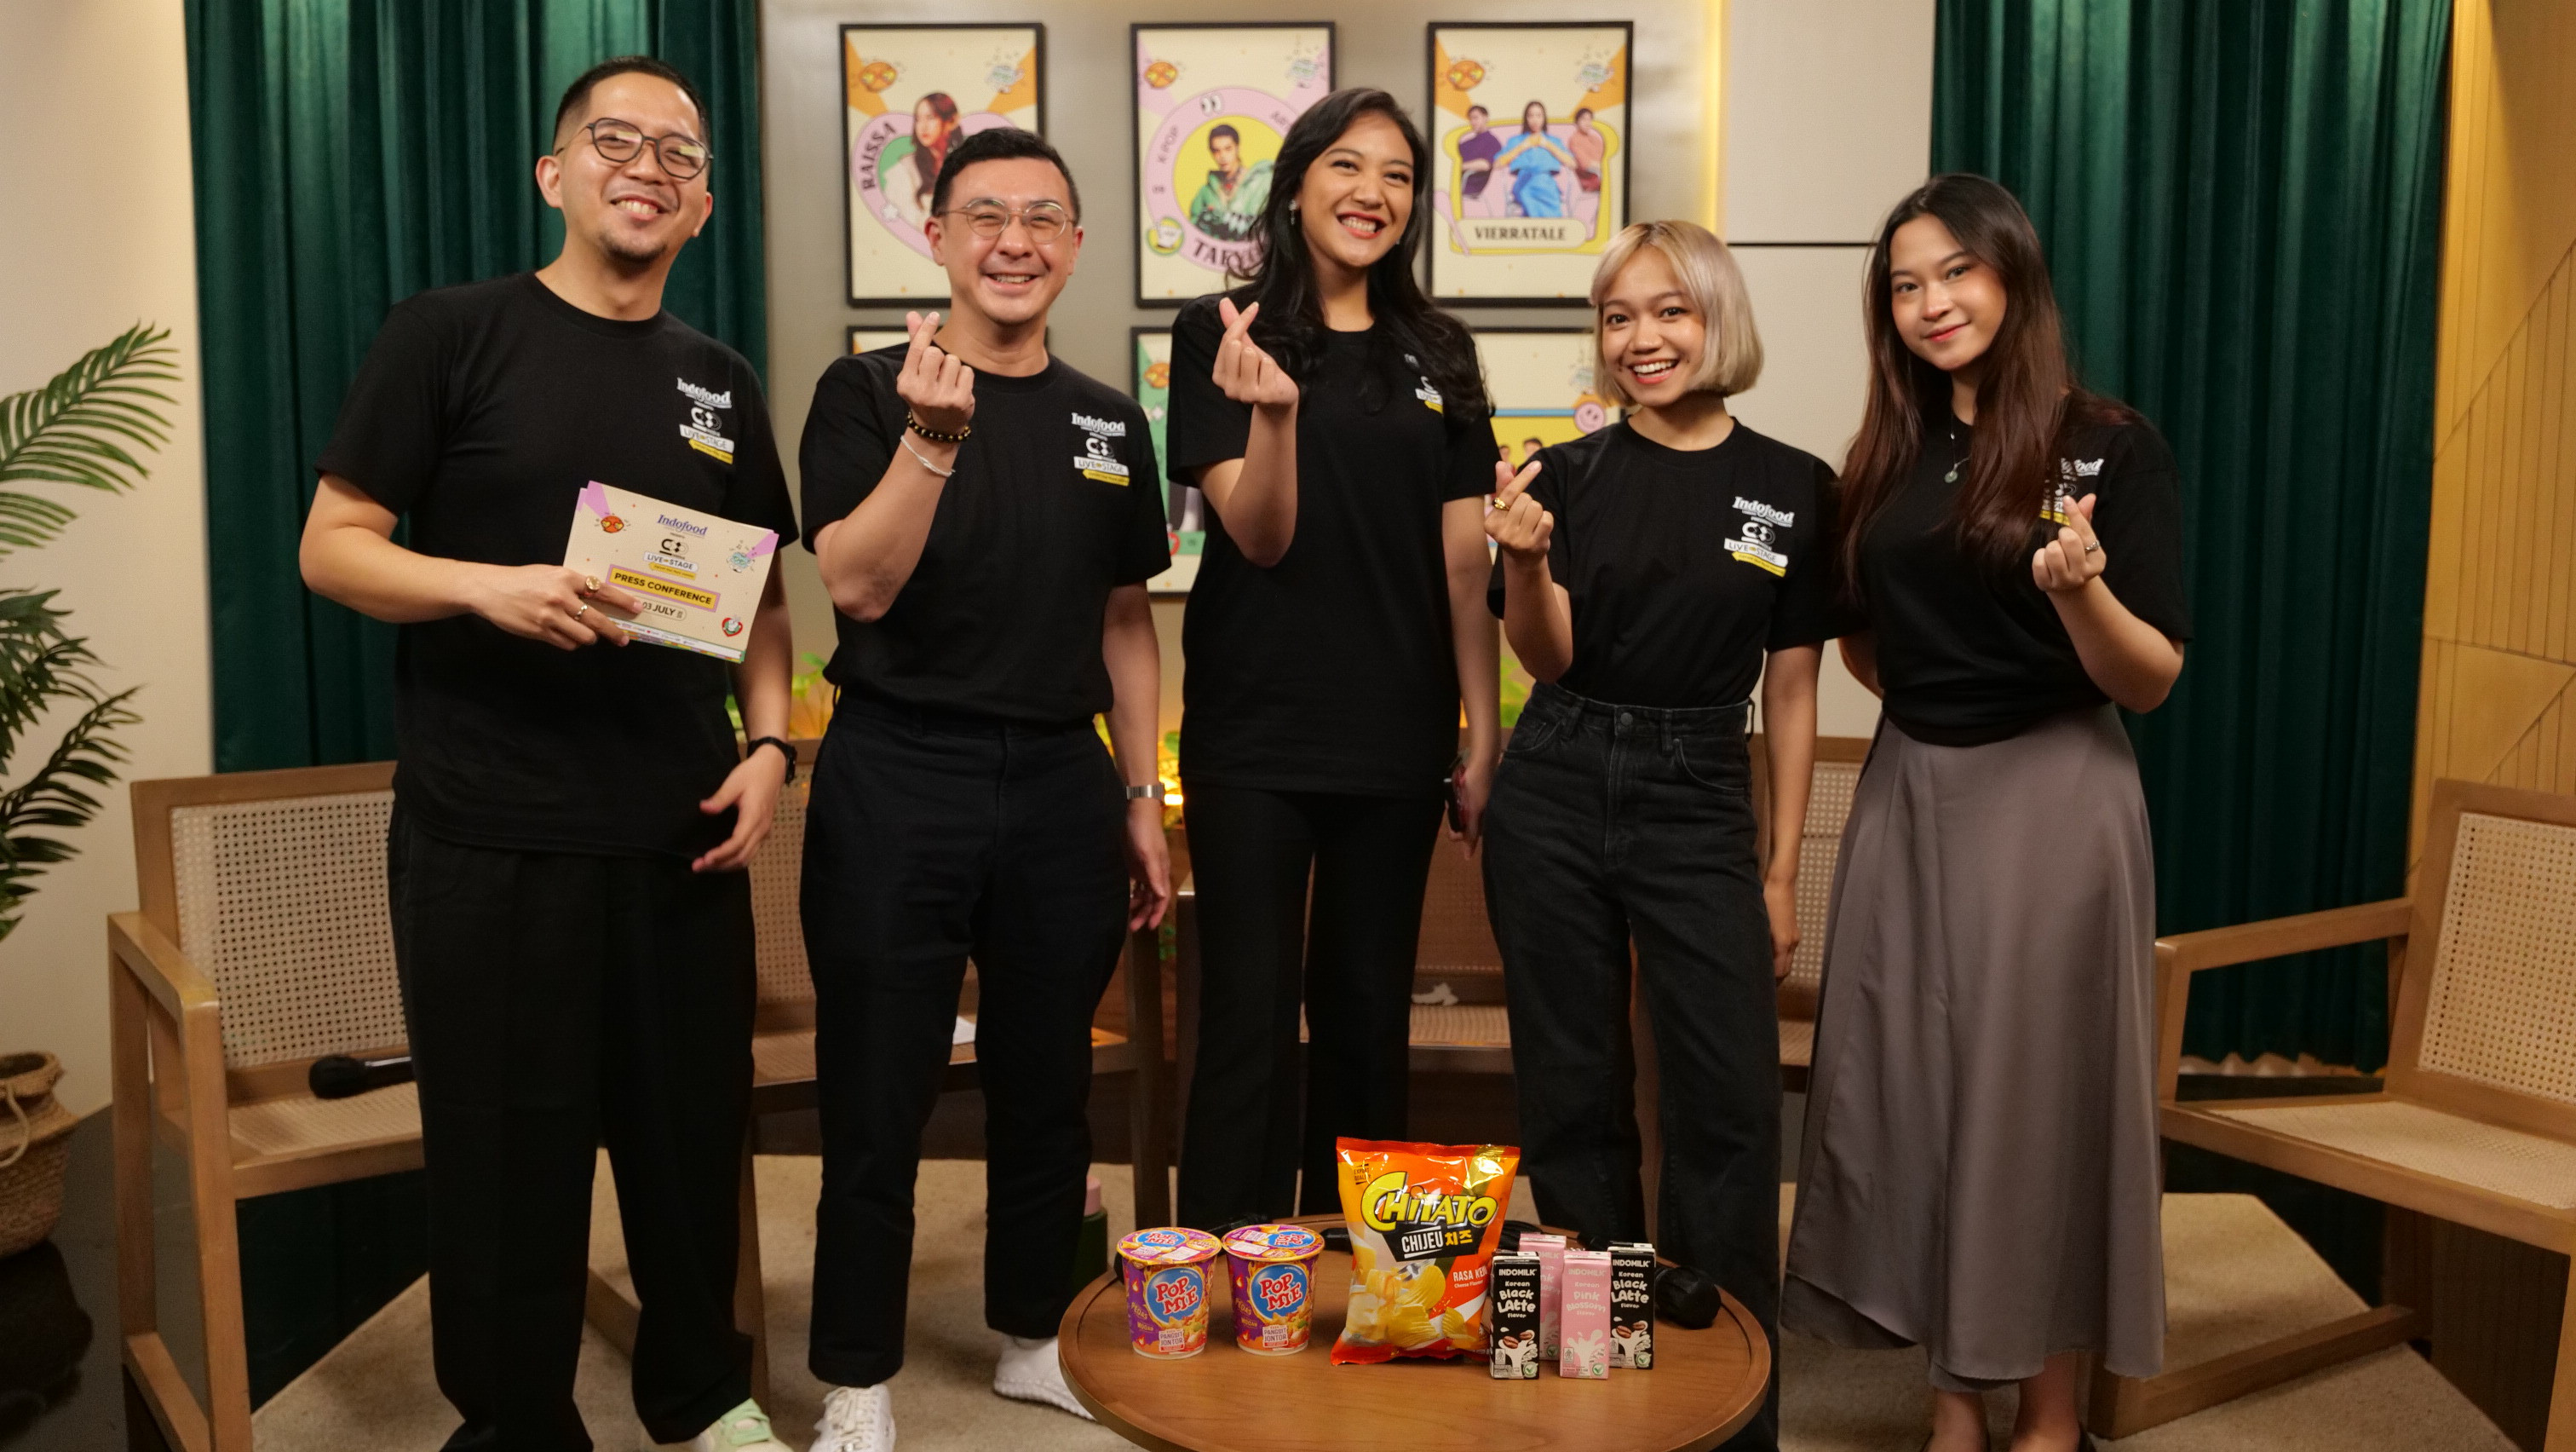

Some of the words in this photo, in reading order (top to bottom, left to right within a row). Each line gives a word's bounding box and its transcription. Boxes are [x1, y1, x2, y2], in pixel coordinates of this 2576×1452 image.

[860, 122, 897, 190] RAISSA
[1475, 226, 1566, 241] VIERRATALE
[676, 377, 732, 404] Indofood
[1071, 412, 1126, 433] Indofood
[1732, 496, 1795, 523] Indofood
[657, 514, 708, 536] Indofood
[647, 554, 663, 563] LIVE
[669, 558, 693, 570] STAGE
[1728, 542, 1748, 552] LIVE
[1756, 547, 1777, 562] STAGE
[614, 573, 646, 587] PRESS
[647, 581, 712, 605] CONFERENCE
[642, 601, 653, 610] 03
[653, 604, 676, 616] JULY
[1401, 1231, 1444, 1253] CHIJEU
[1445, 1230, 1473, 1247] 치즈
[1498, 1268, 1536, 1276] INDOMILK
[1568, 1268, 1606, 1276] INDOMILK
[1613, 1259, 1649, 1268] INDOMILK
[1260, 1273, 1293, 1298] POP
[1453, 1270, 1474, 1282] RASA
[1613, 1280, 1648, 1291] Black
[1155, 1276, 1189, 1302] POP
[1267, 1282, 1302, 1311] MIE
[1498, 1288, 1535, 1301] Black
[1163, 1286, 1199, 1315] MIE
[1567, 1302, 1606, 1313] Blossom
[1160, 1337, 1182, 1345] JONTOR
